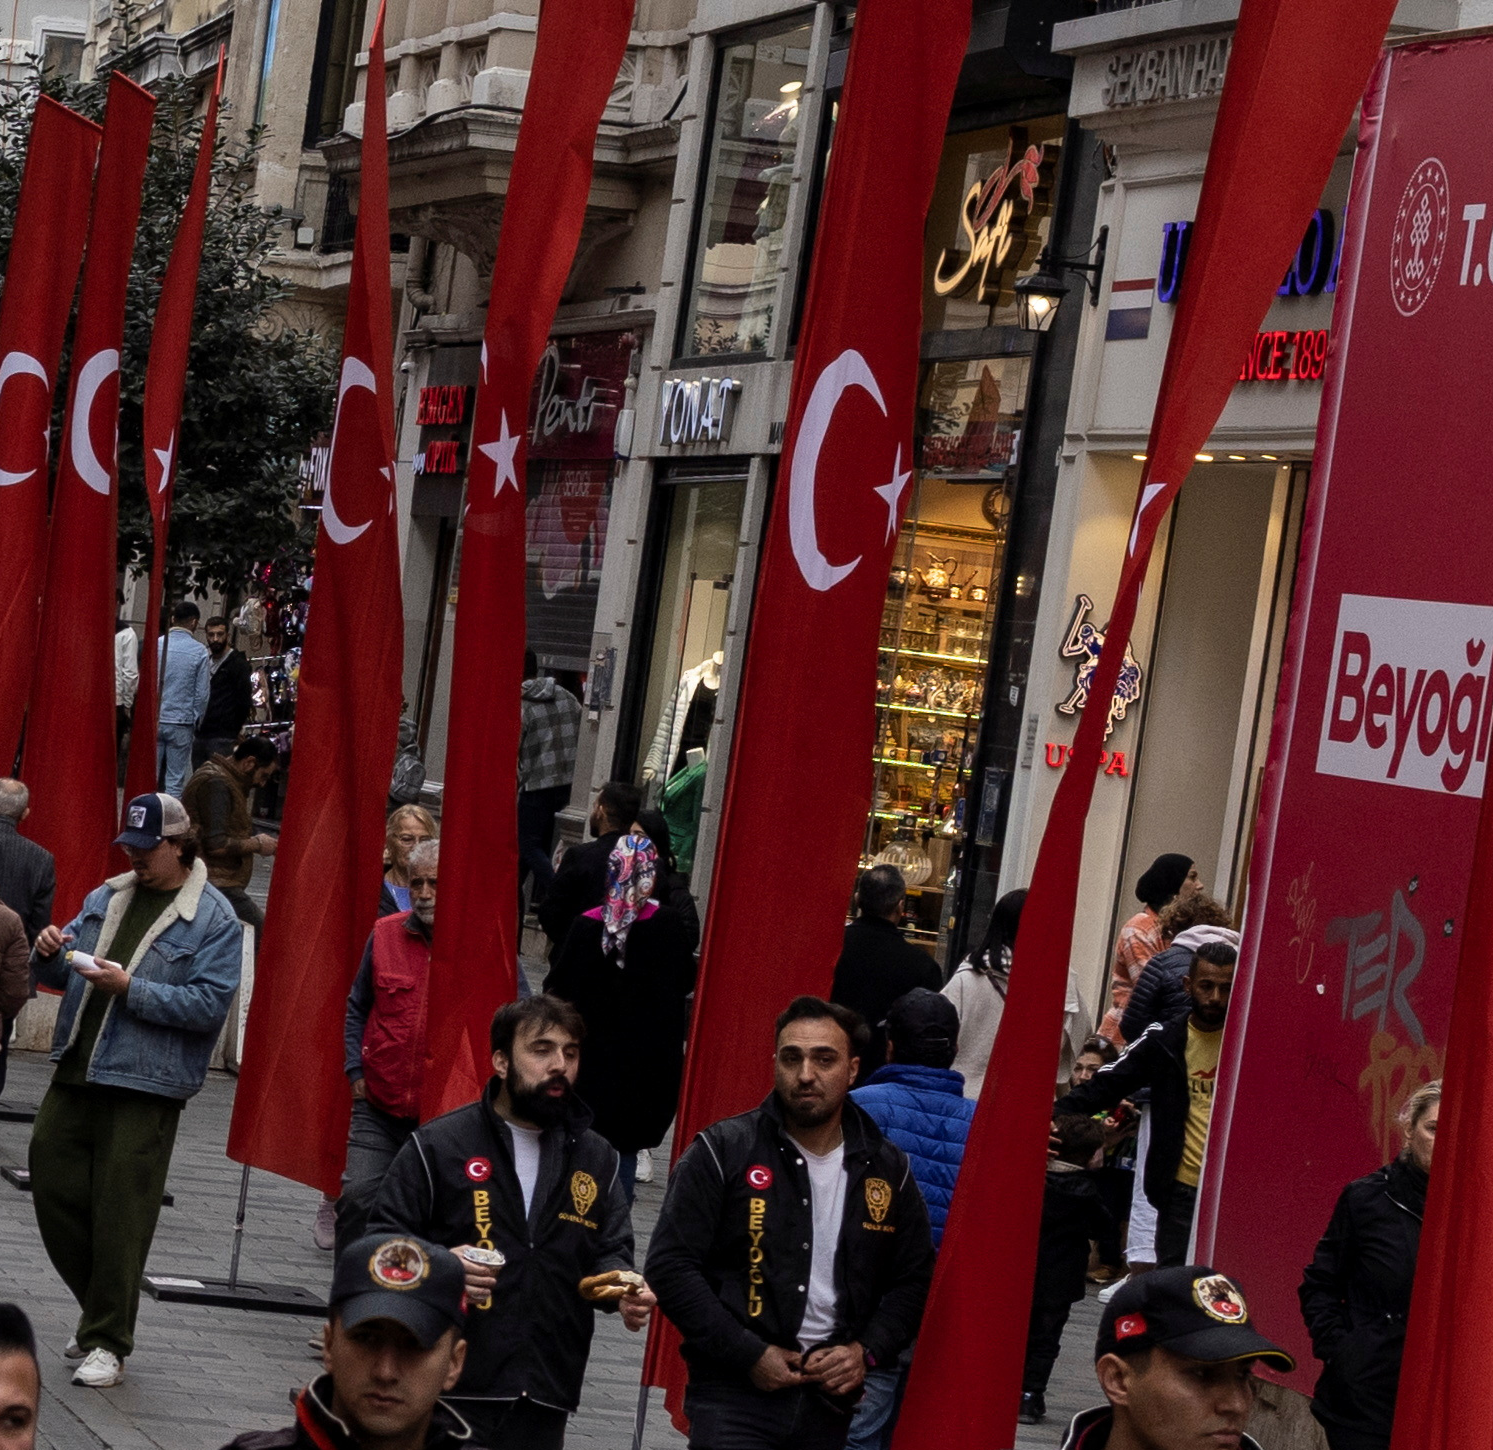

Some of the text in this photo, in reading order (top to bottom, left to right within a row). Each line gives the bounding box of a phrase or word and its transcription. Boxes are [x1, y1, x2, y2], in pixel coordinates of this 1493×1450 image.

[1101, 45, 1188, 107] SEKBAN
[1239, 329, 1327, 381] NCE 189
[748, 1197, 766, 1318] BEYOĞLU
